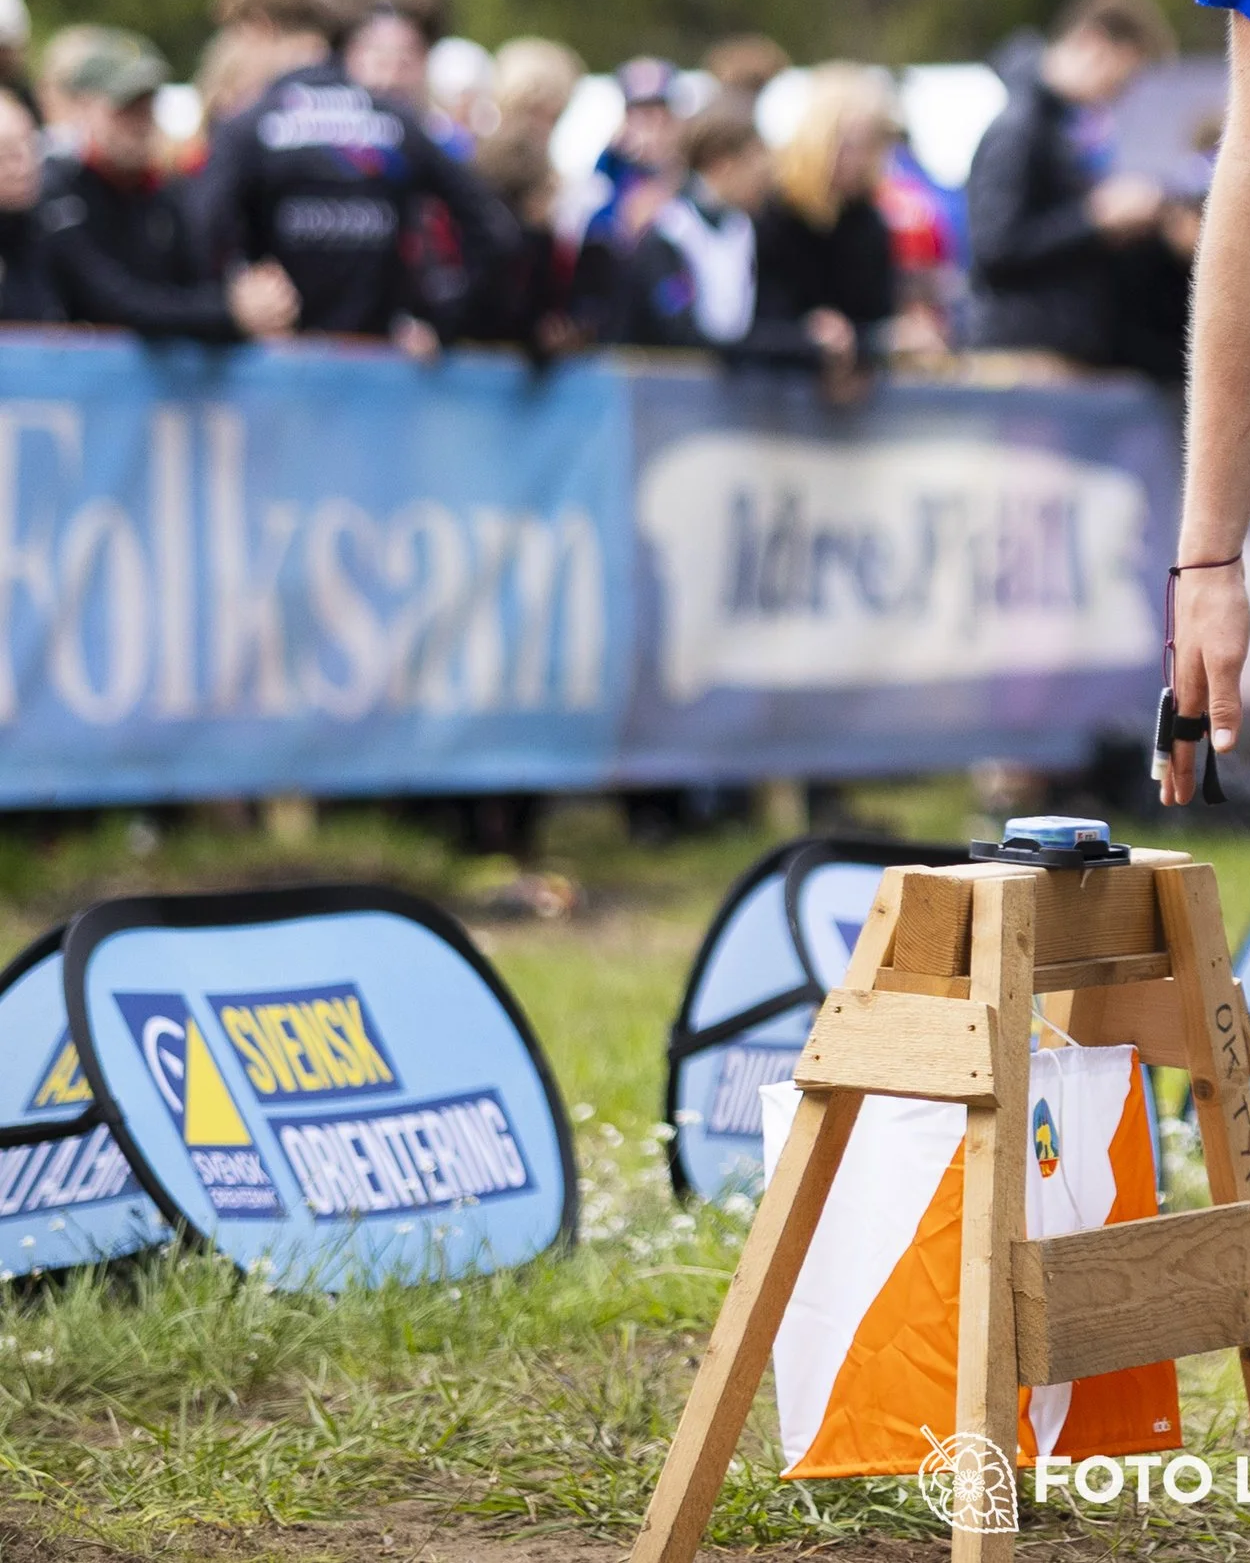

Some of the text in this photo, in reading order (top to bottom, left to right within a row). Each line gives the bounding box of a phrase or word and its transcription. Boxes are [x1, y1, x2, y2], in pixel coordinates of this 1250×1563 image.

[0, 398, 607, 728] Folksam
[220, 994, 395, 1095] SVENSK
[279, 1096, 527, 1216] ORIENTERING
